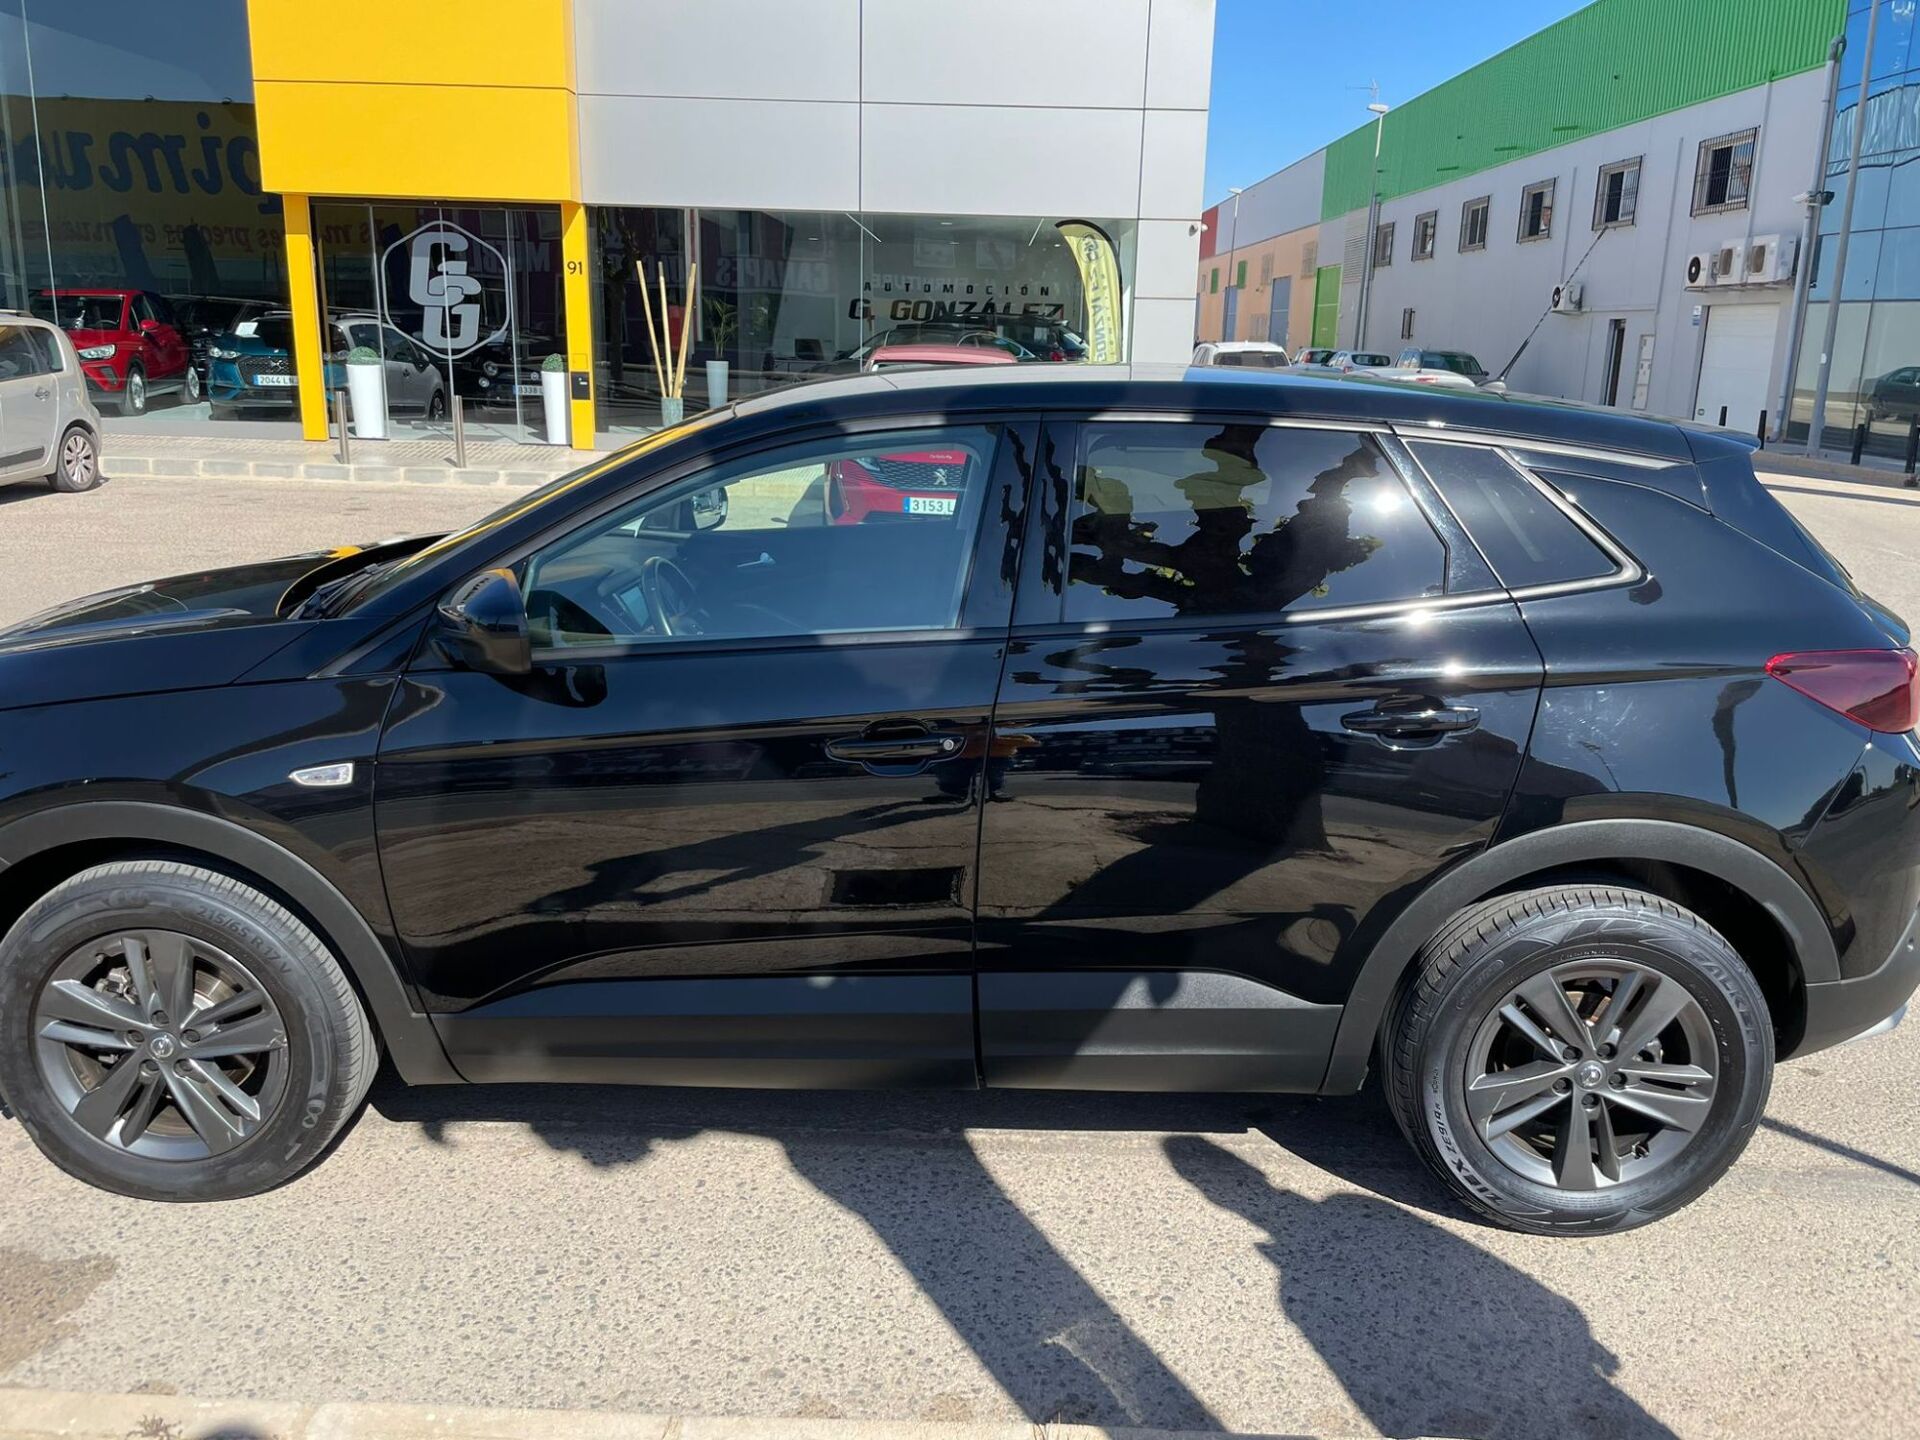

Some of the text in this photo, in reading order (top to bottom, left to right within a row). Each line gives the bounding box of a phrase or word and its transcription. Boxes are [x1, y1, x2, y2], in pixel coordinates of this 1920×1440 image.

[567, 261, 584, 275] 91
[863, 281, 1049, 297] AUTOMOCIÓN
[912, 499, 944, 512] 3153
